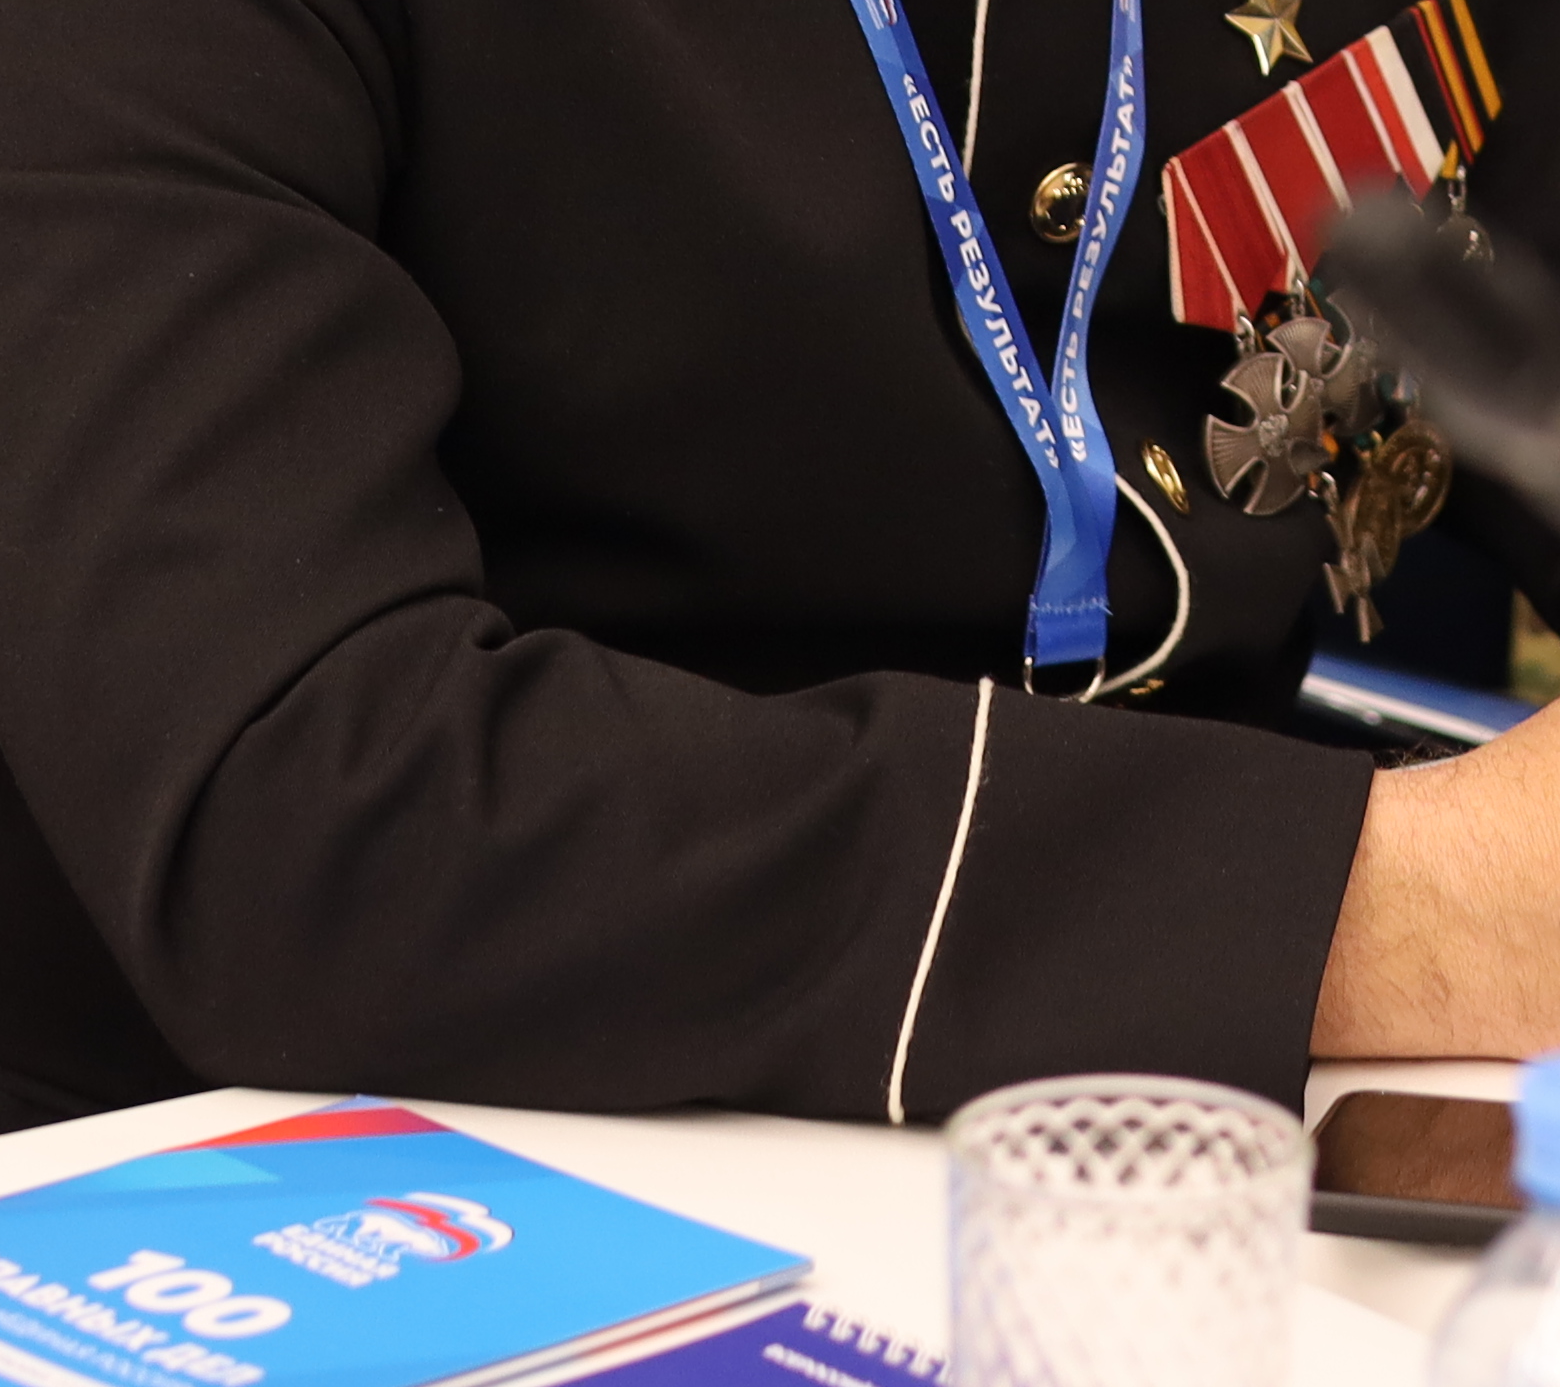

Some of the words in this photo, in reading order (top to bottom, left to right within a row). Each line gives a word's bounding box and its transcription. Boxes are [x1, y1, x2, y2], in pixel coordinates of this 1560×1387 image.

[902, 73, 958, 203] «ЕСТЬ
[949, 212, 1059, 470] РЕЗУЛЬТАТ»
[1072, 53, 1137, 321] РЕЗУЛЬТАТ»
[1060, 328, 1089, 464] «ЕСТЬ
[88, 1248, 293, 1340] 100
